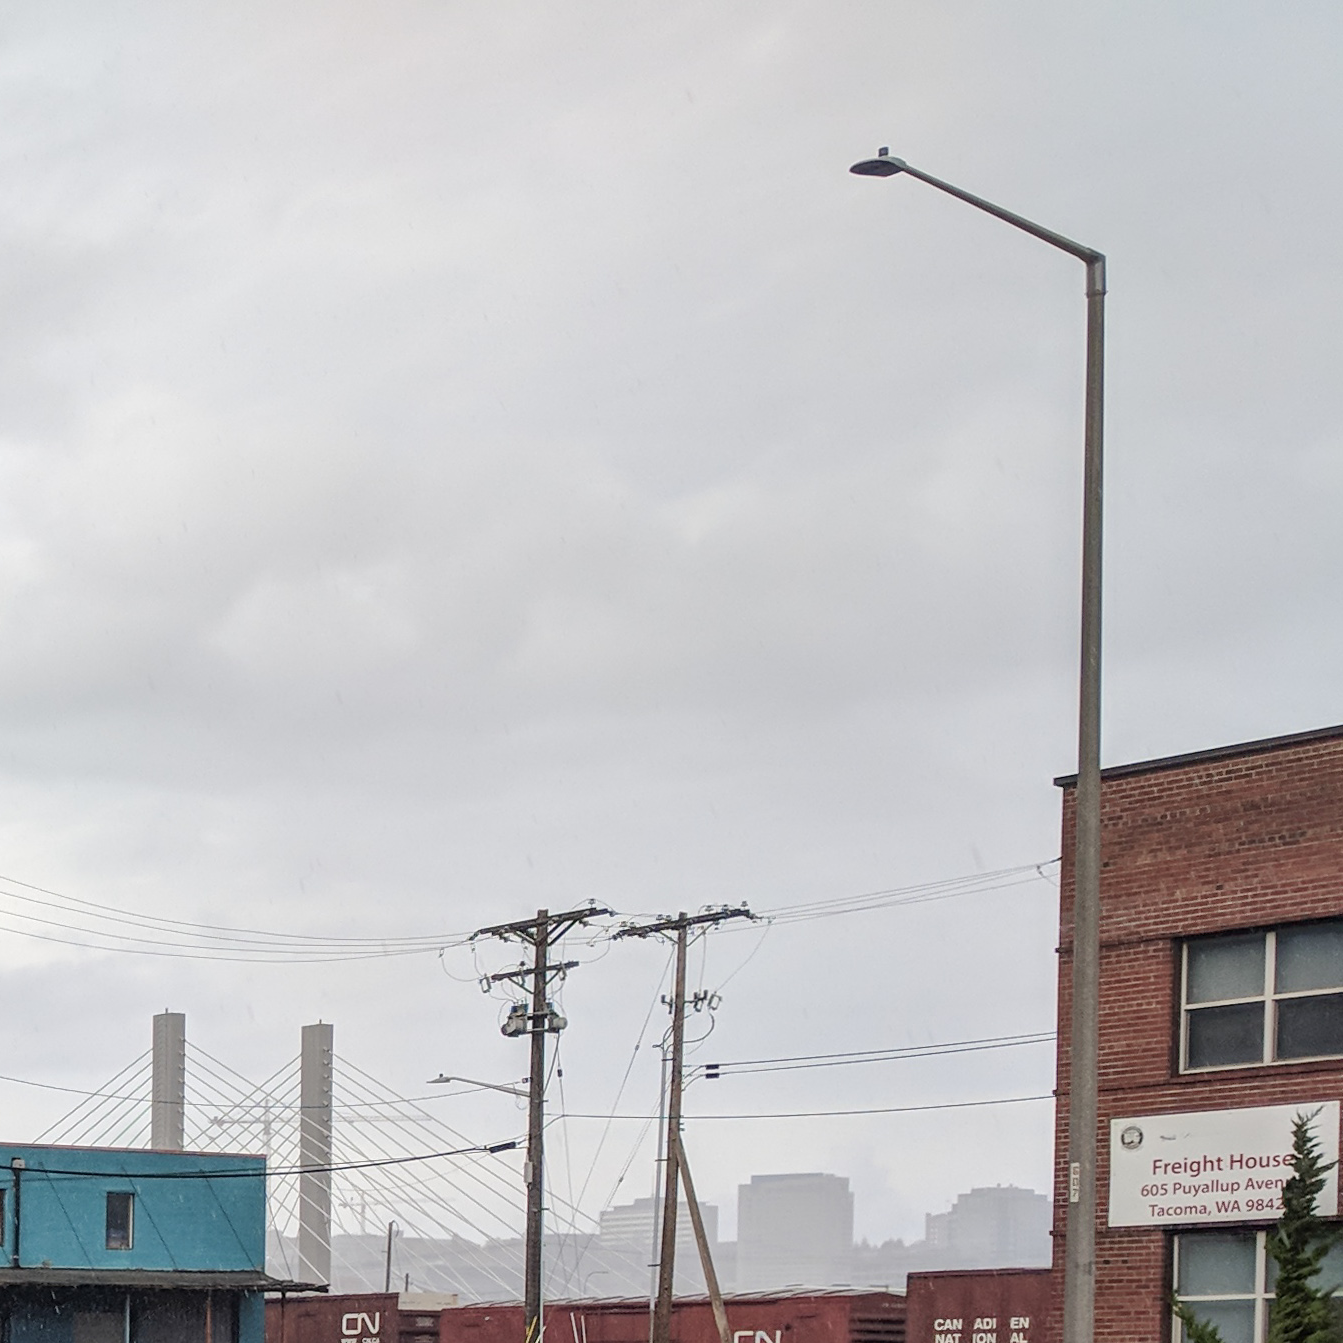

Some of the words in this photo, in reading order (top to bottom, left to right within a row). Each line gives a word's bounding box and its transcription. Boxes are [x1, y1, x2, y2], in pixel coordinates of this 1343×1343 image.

[1152, 1154, 1223, 1177] Freight
[1230, 1153, 1294, 1170] House
[1141, 1183, 1168, 1197] 605
[1173, 1180, 1240, 1197] Puyallup
[1149, 1203, 1212, 1217] Tacoma,
[1216, 1200, 1241, 1213] WA
[1246, 1197, 1285, 1212] 9842
[341, 1312, 380, 1335] CN
[934, 1319, 963, 1331] CAN
[973, 1317, 997, 1330] ADI
[1010, 1317, 1030, 1329] EN
[1010, 1332, 1028, 1343] AL
